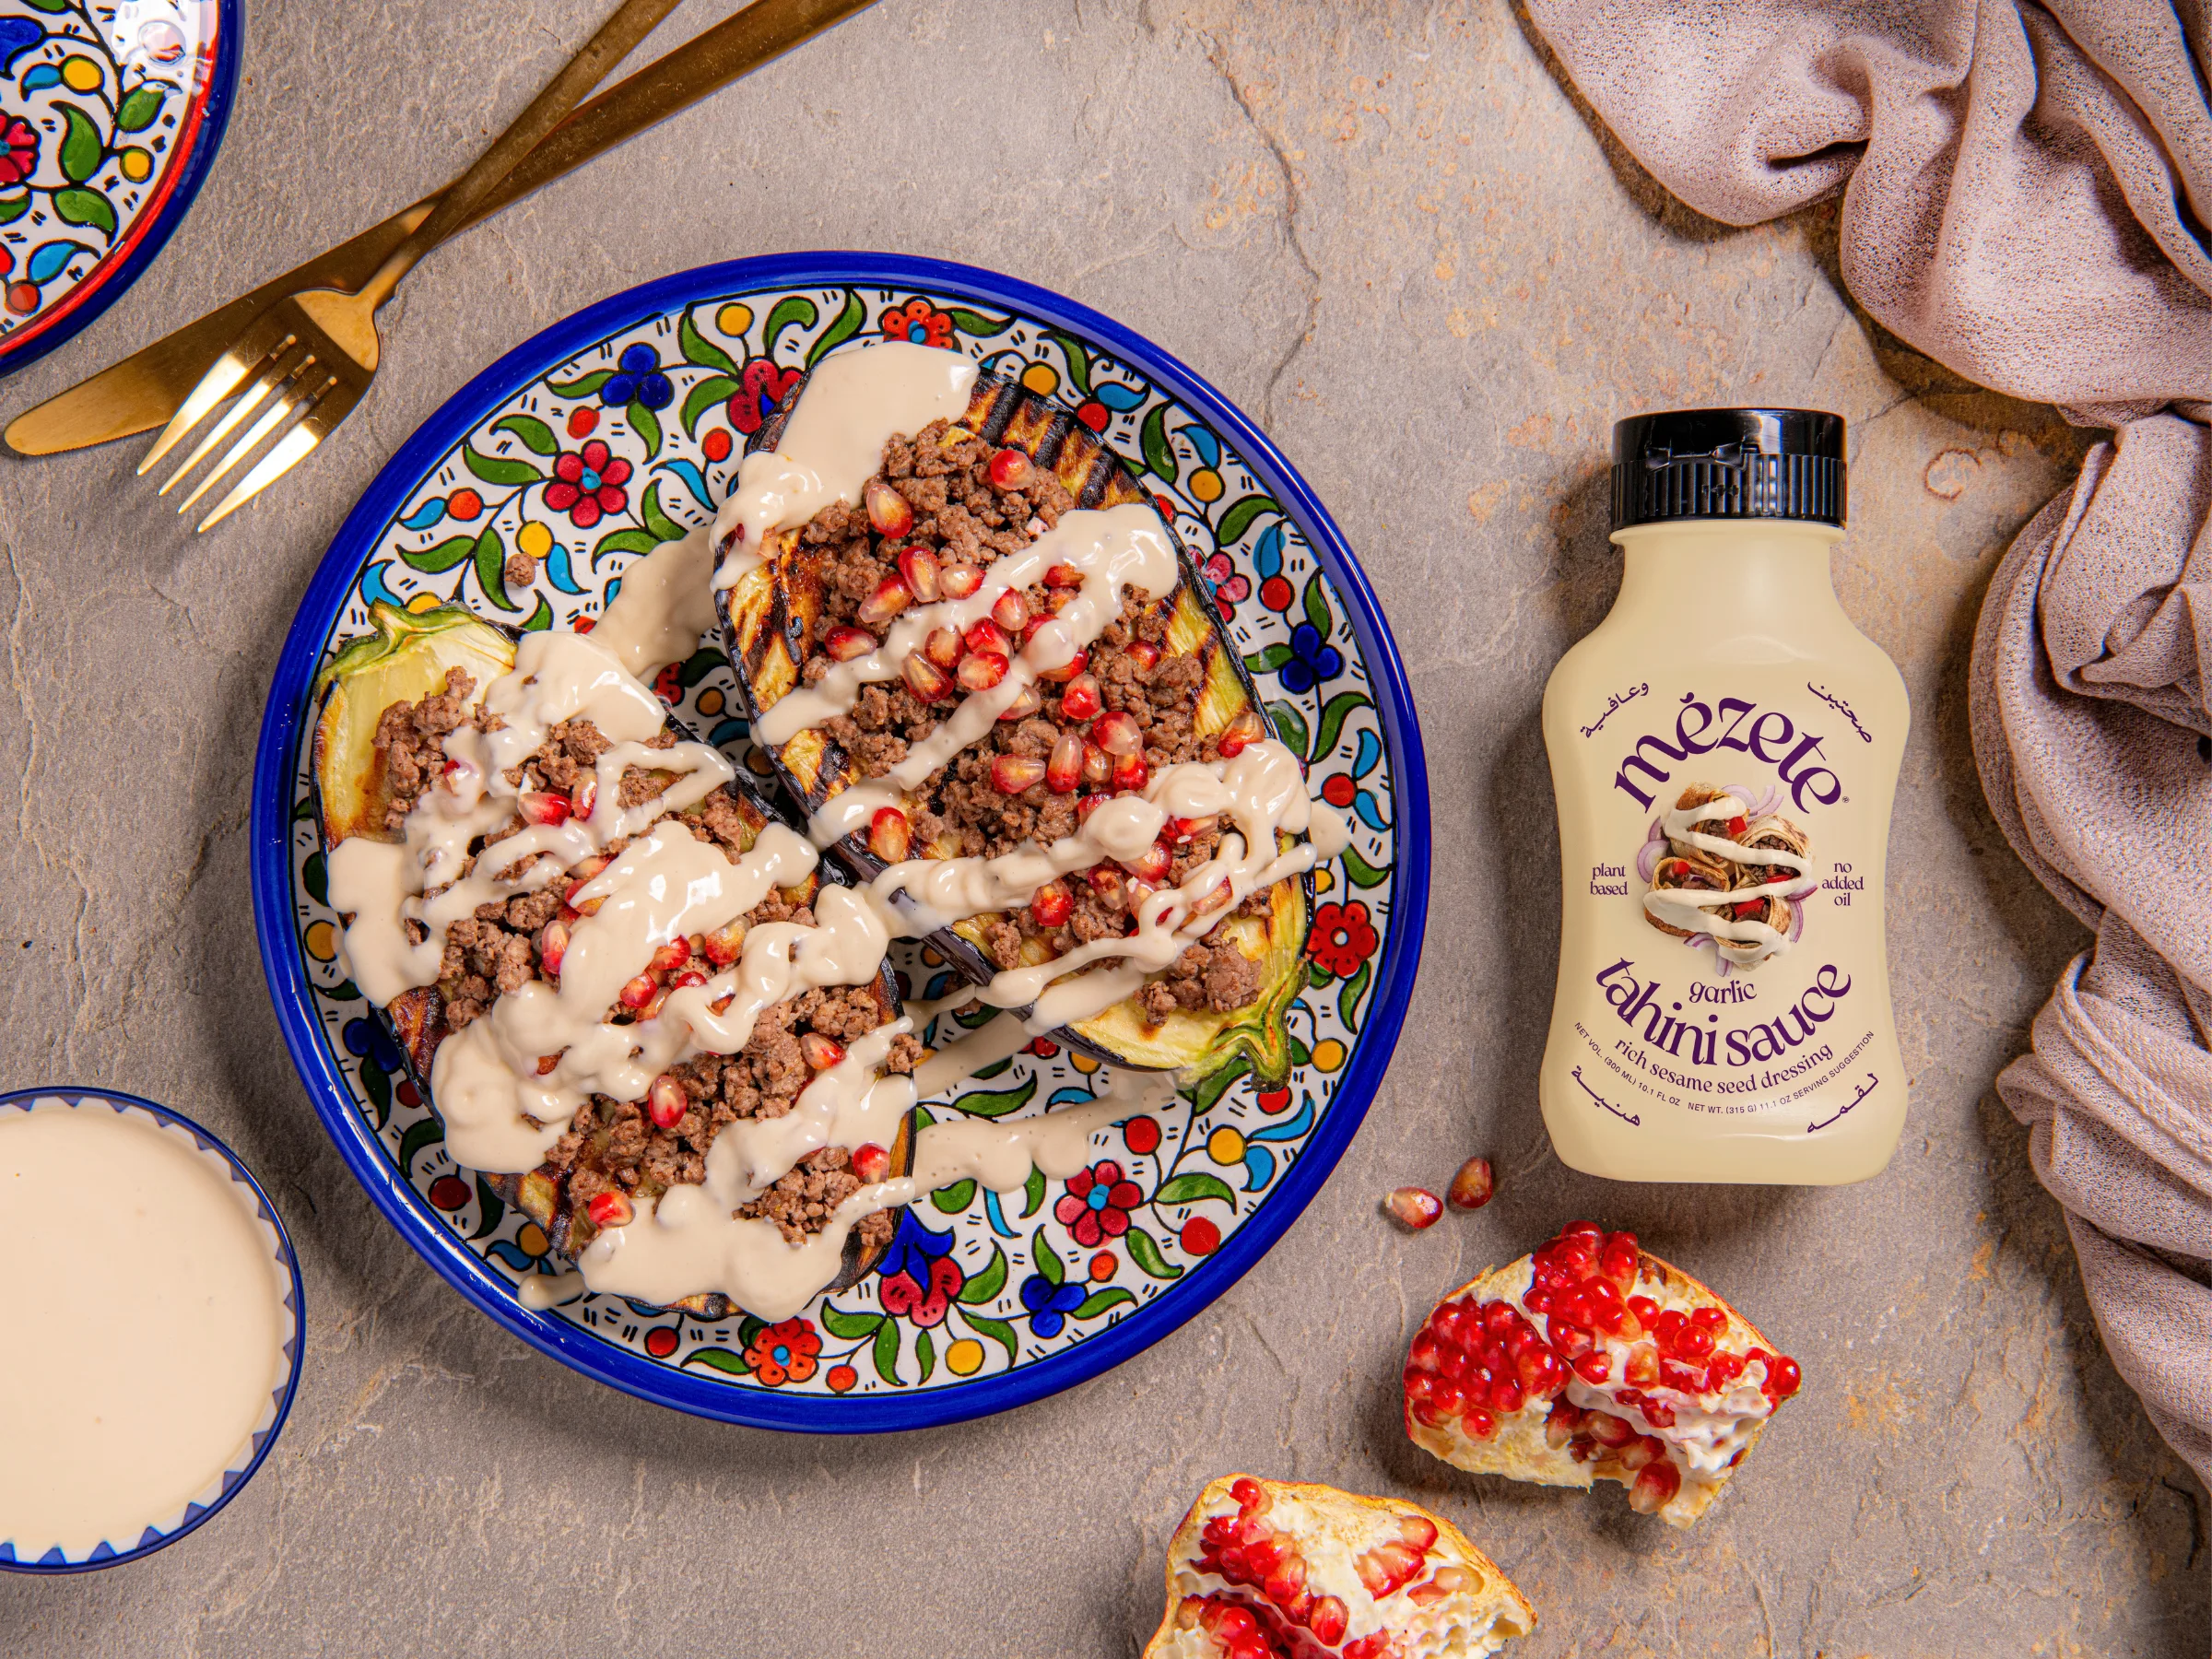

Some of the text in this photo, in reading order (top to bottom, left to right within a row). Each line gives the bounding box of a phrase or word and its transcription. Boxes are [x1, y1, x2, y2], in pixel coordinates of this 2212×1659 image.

[1592, 863, 1626, 880] plant
[1833, 863, 1853, 874] no
[1590, 880, 1629, 896] based
[1821, 875, 1865, 891] added
[1833, 891, 1852, 907] oil
[1688, 979, 1758, 1005] garlic
[1595, 957, 1852, 1067] tahini sauce
[1574, 1021, 1875, 1114] NET VOL. (300 ML) 10.1 FL OZ NET WT. (315 G) 11.1 OZ SERVING SUGGESTION
[1614, 1039, 1834, 1095] rich sesame seed dressing
